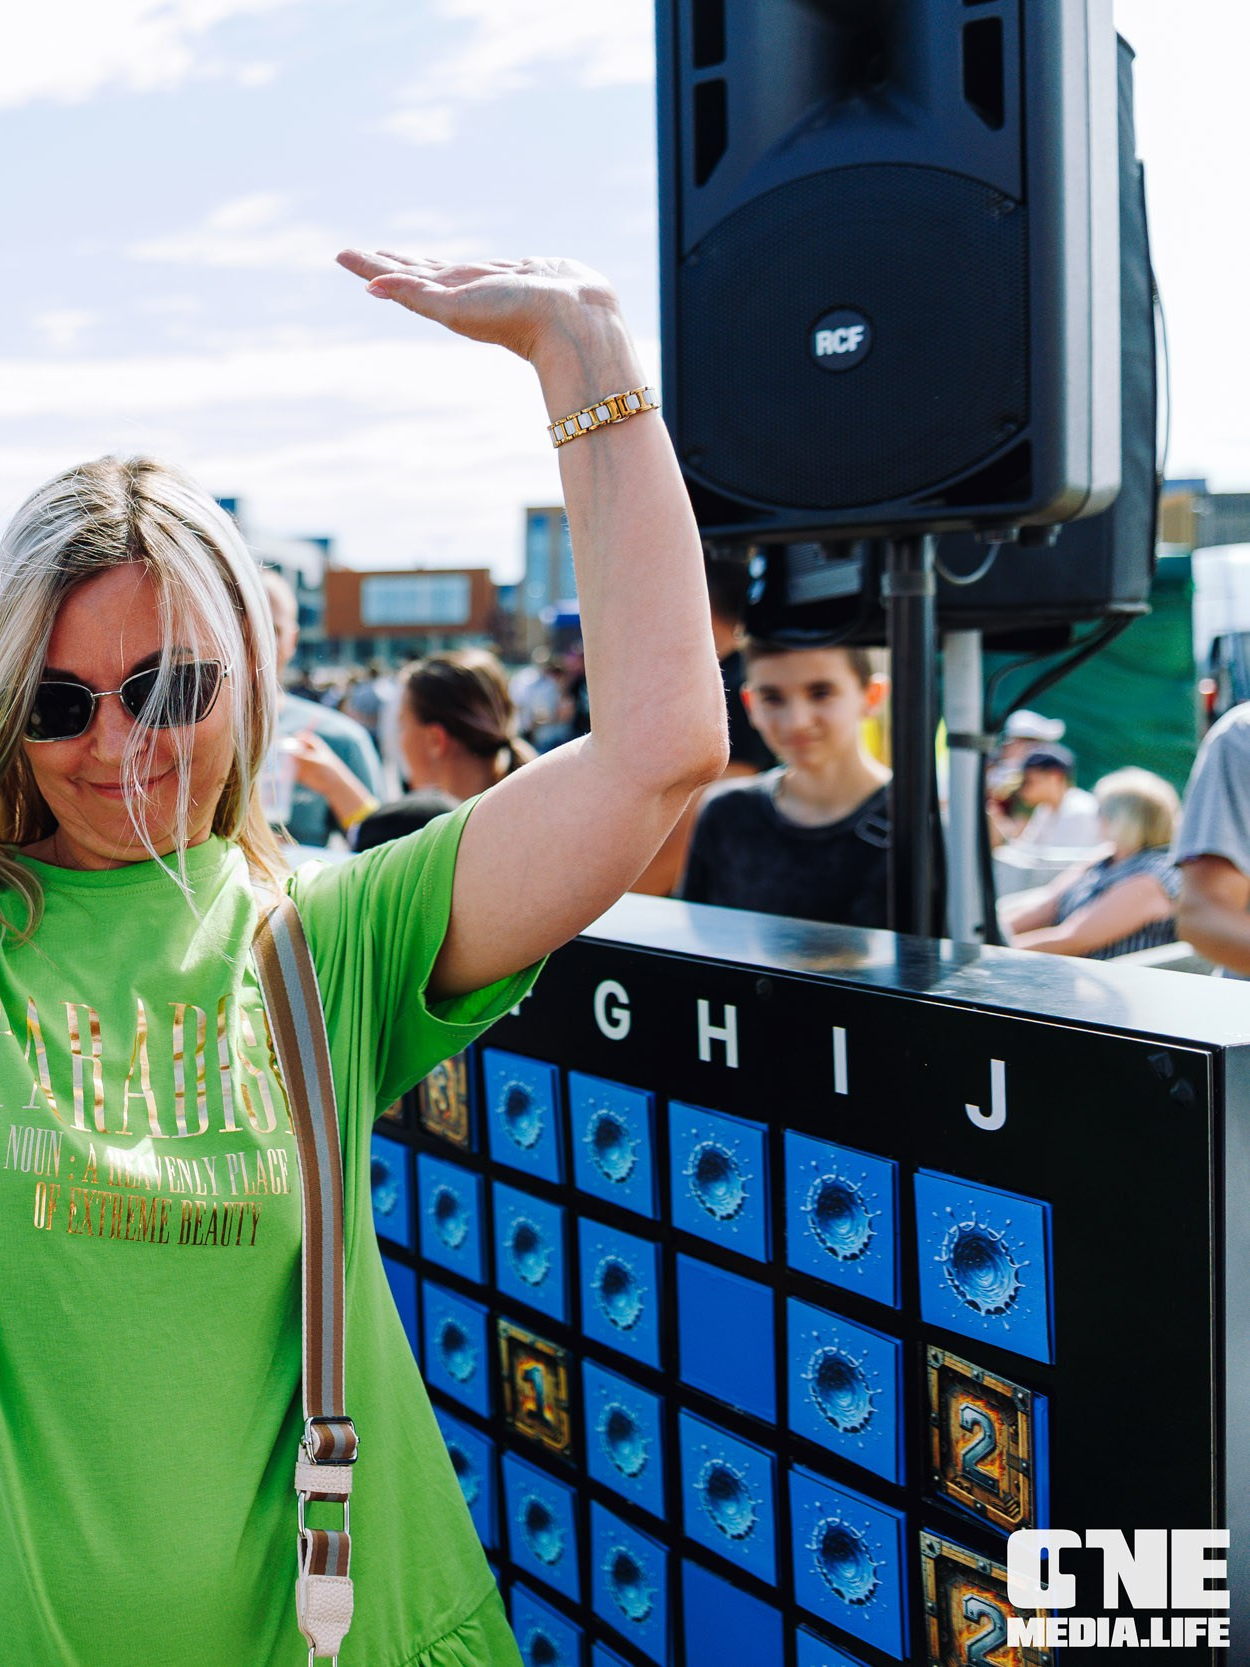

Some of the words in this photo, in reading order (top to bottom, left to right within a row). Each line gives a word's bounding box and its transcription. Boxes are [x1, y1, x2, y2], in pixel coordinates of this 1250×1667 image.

[816, 325, 864, 356] RCF
[594, 980, 631, 1041] G
[697, 999, 739, 1069] H
[832, 1026, 849, 1096] I
[965, 1058, 1007, 1132] J
[3, 1124, 65, 1178] NOUN
[81, 1142, 99, 1184] A
[106, 1145, 219, 1196] HEAVENLY
[225, 1148, 292, 1196] PLACE
[33, 1181, 61, 1230] OF
[66, 1187, 172, 1244] EXTREME
[177, 1199, 263, 1247] BEAUTY
[960, 1402, 999, 1493] 2
